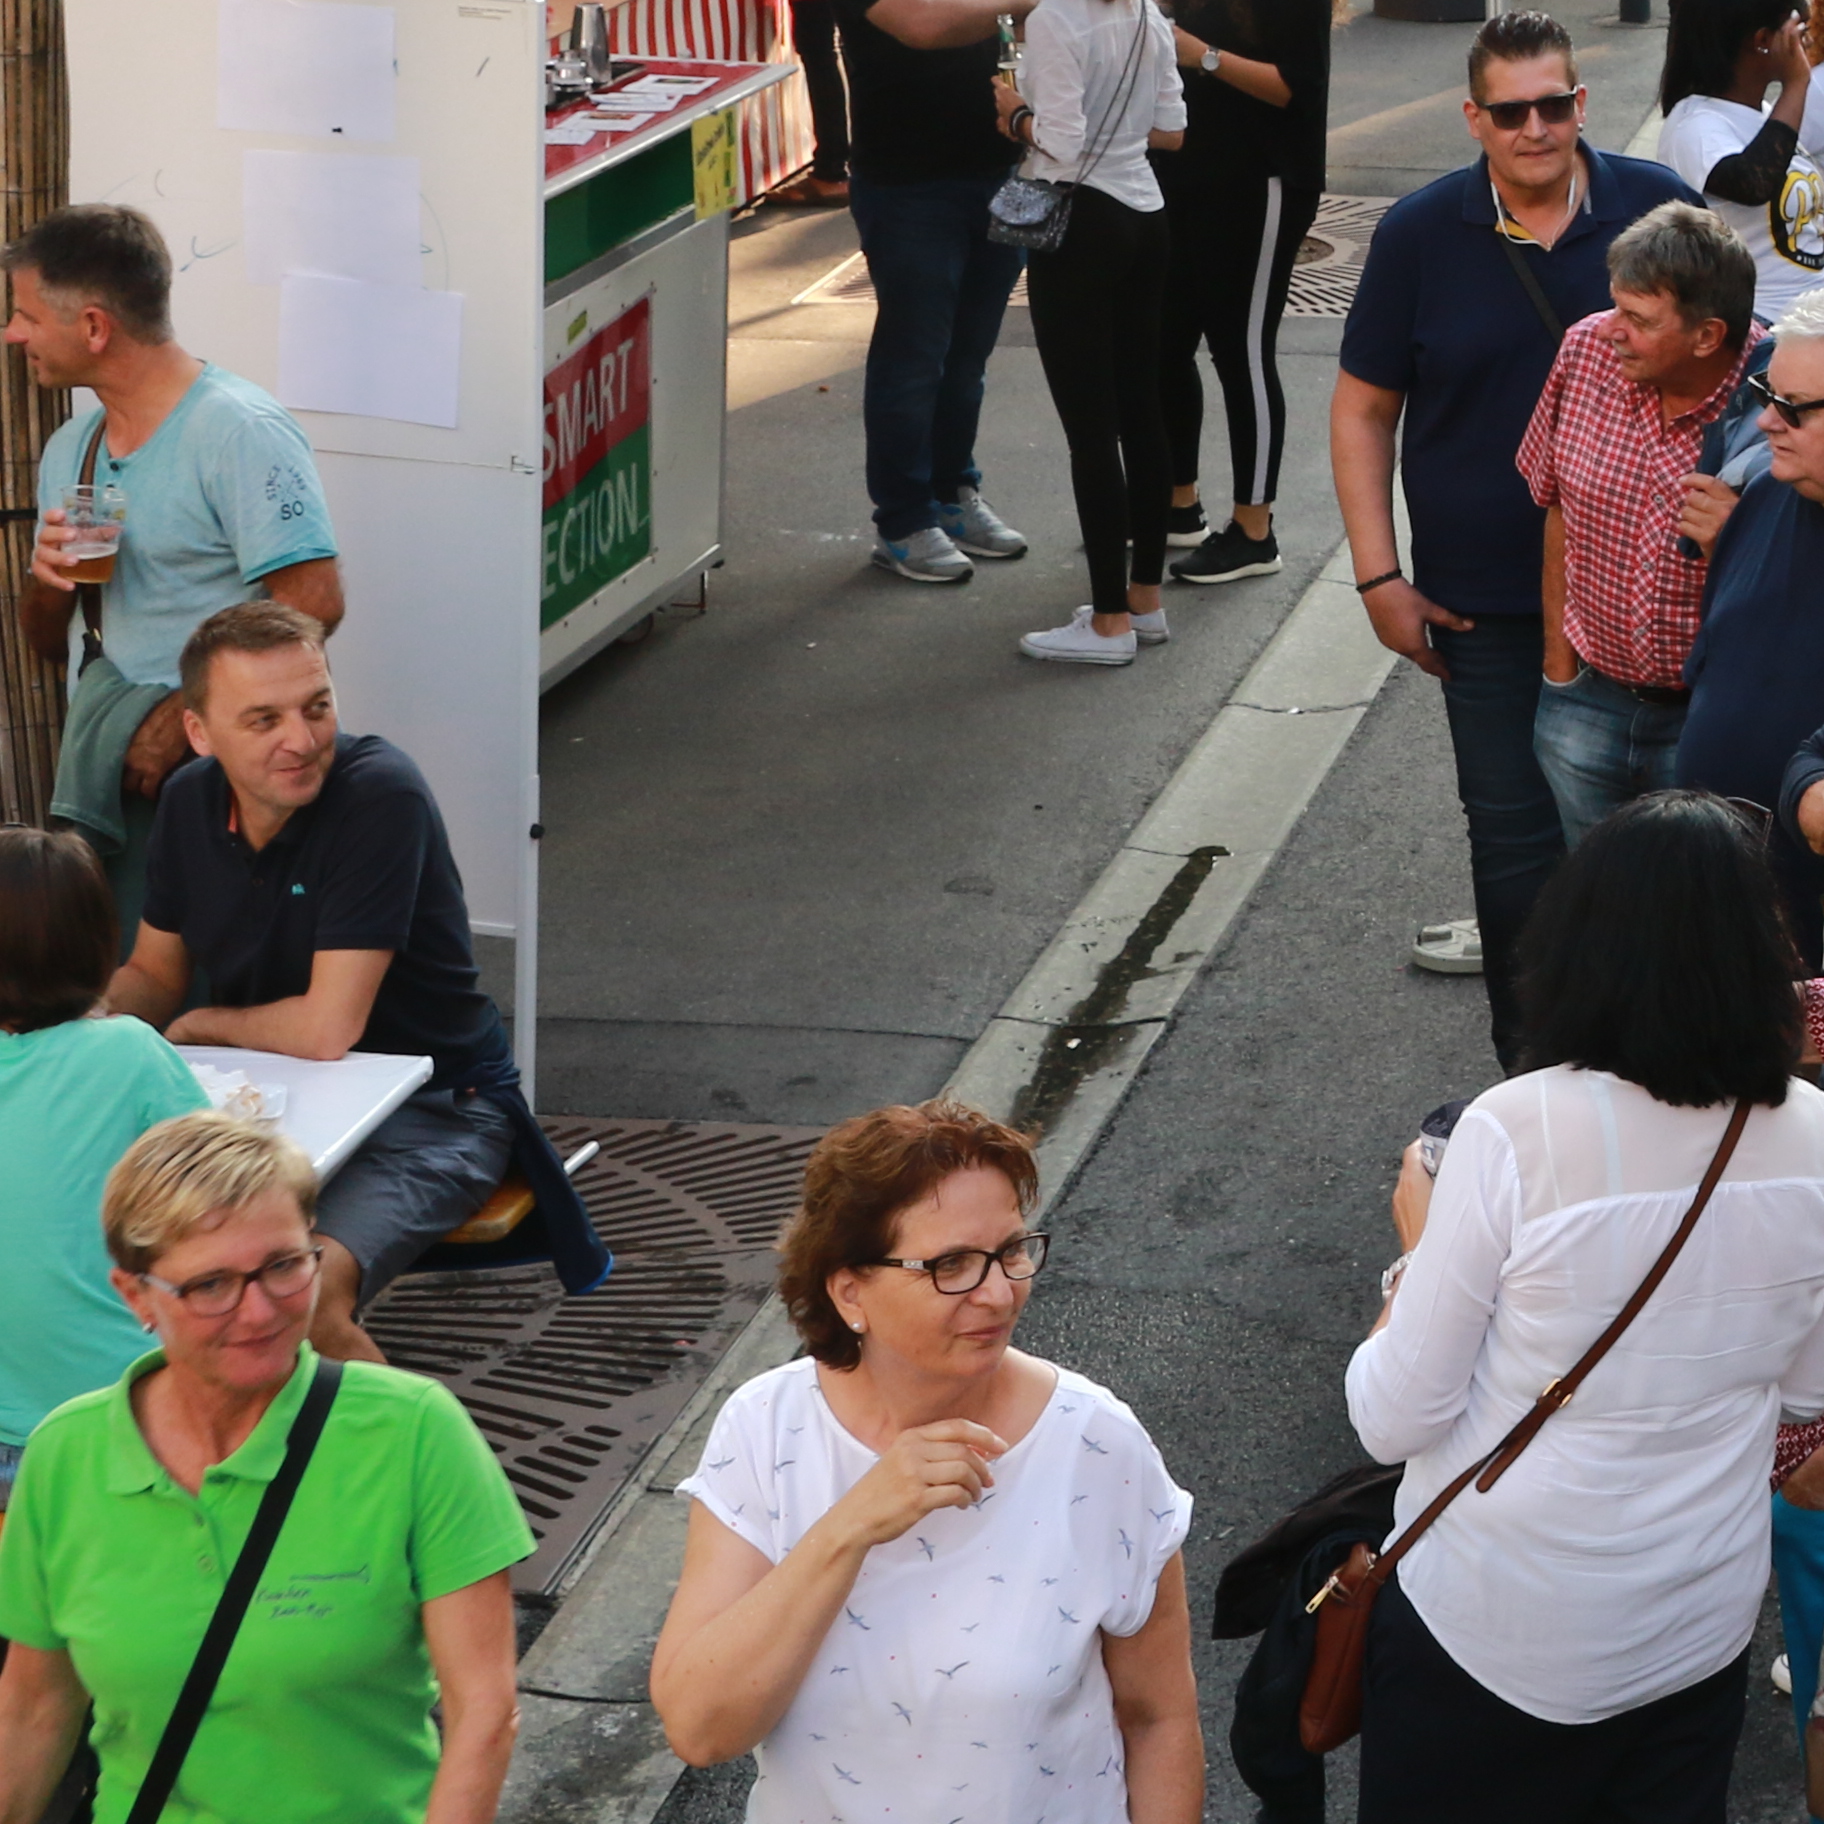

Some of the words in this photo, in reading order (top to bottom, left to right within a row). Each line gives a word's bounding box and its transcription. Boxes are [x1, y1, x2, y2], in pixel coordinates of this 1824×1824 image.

[543, 339, 635, 482] SMART
[280, 500, 305, 521] SO
[543, 462, 640, 601] ECTION
